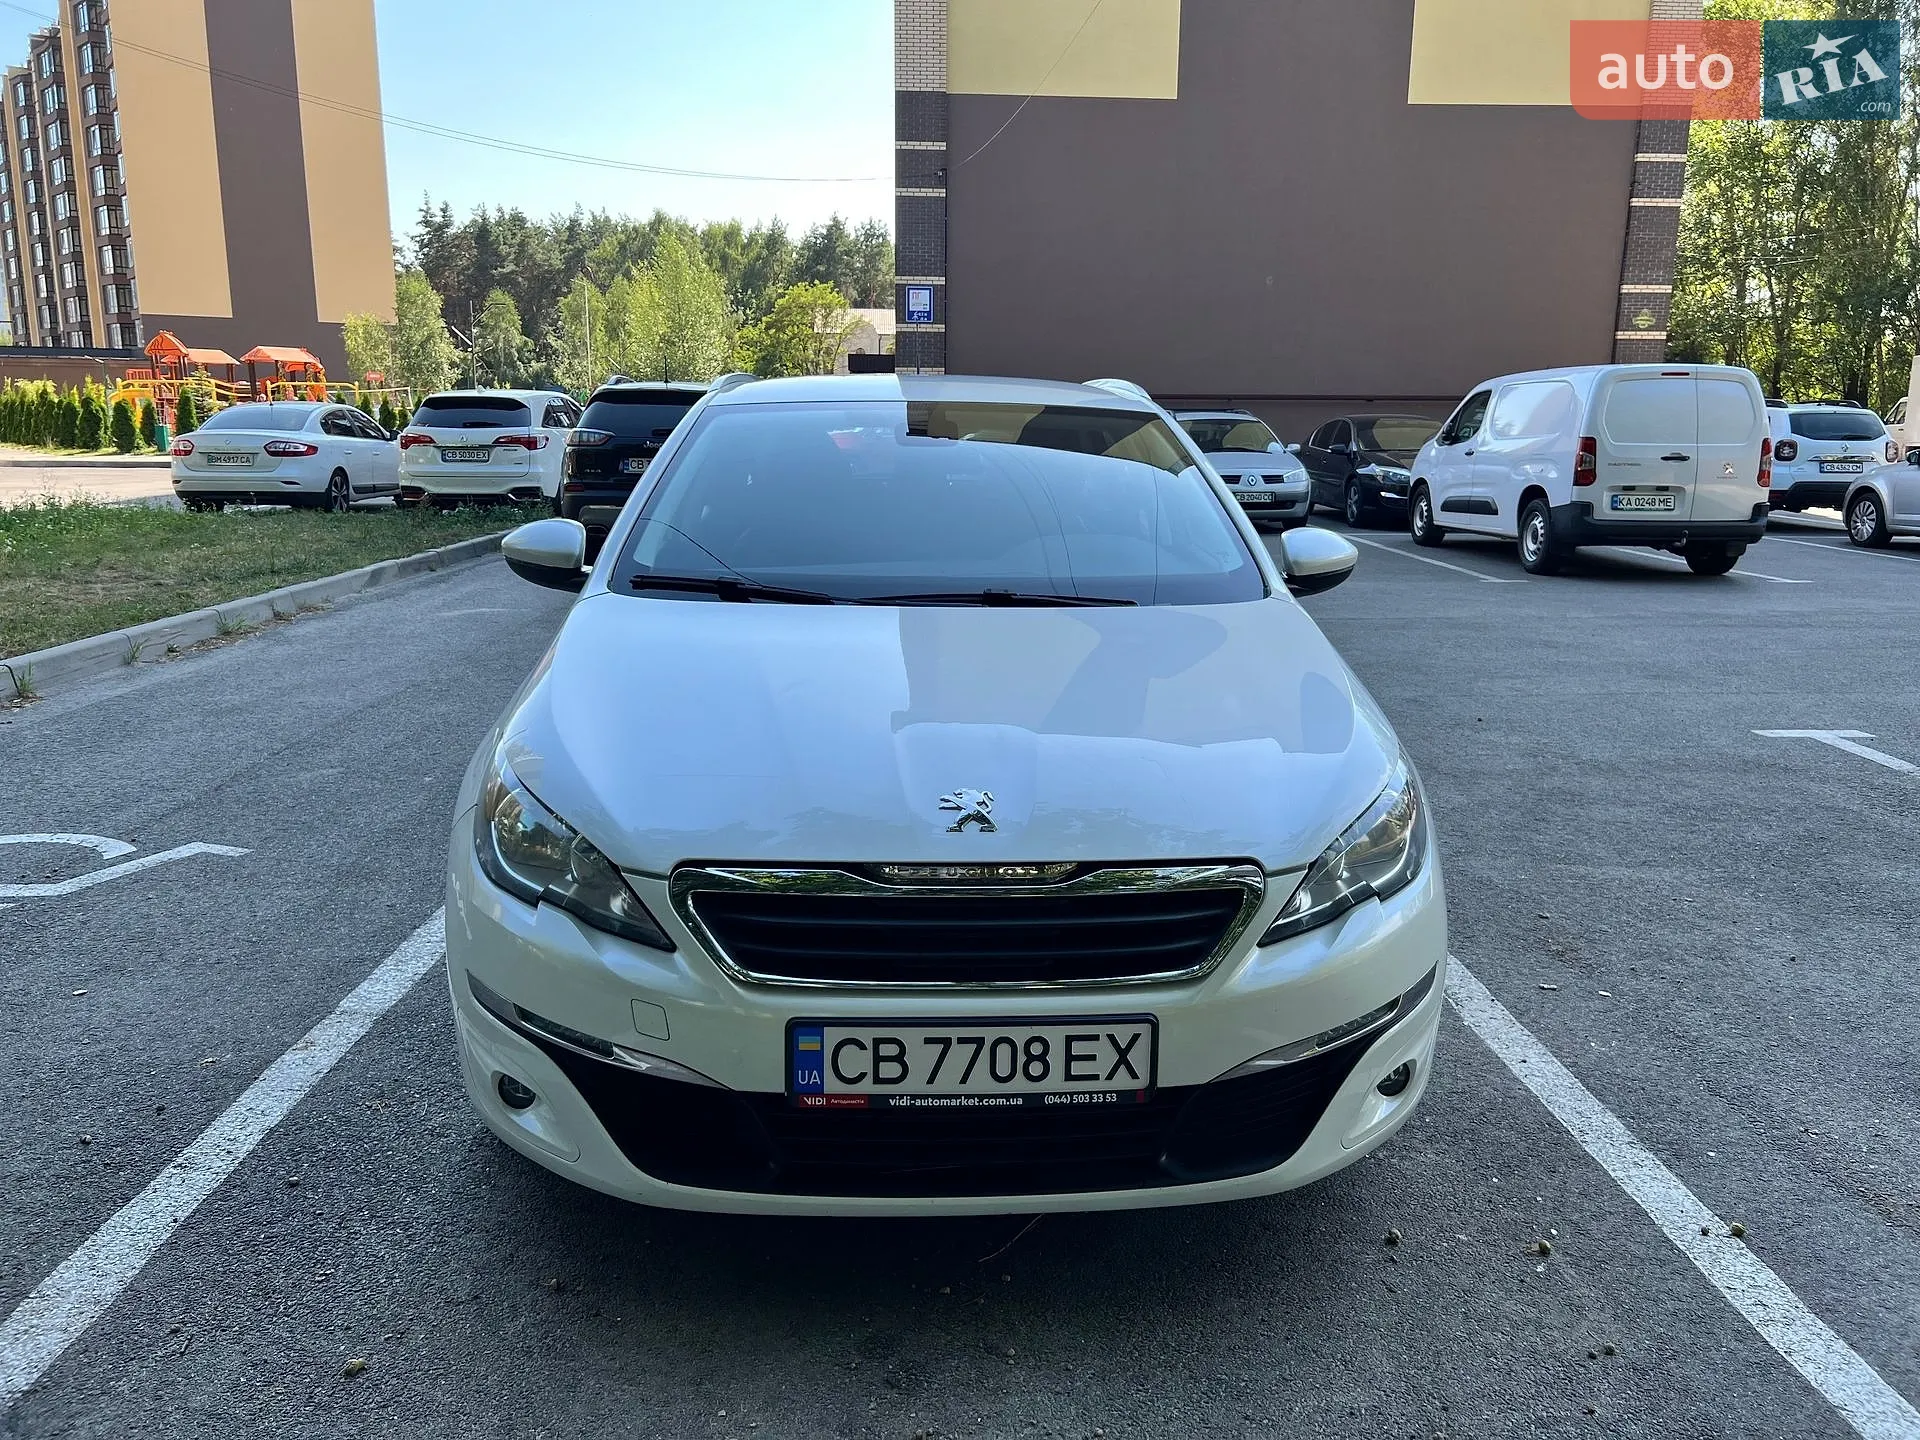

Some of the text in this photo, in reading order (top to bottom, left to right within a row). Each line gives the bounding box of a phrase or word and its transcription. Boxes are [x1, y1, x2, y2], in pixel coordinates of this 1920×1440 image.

[446, 450, 488, 459] CB 5030 EX
[630, 460, 644, 469] CB
[1618, 497, 1673, 507] KA 0248 ME
[830, 1032, 1142, 1086] CB 7708 EX
[798, 1069, 821, 1085] UA
[803, 1096, 827, 1106] VIDI
[889, 1096, 1023, 1107] vidi-automarket.com.ua
[1044, 1093, 1117, 1104] (044) 503 33 53
